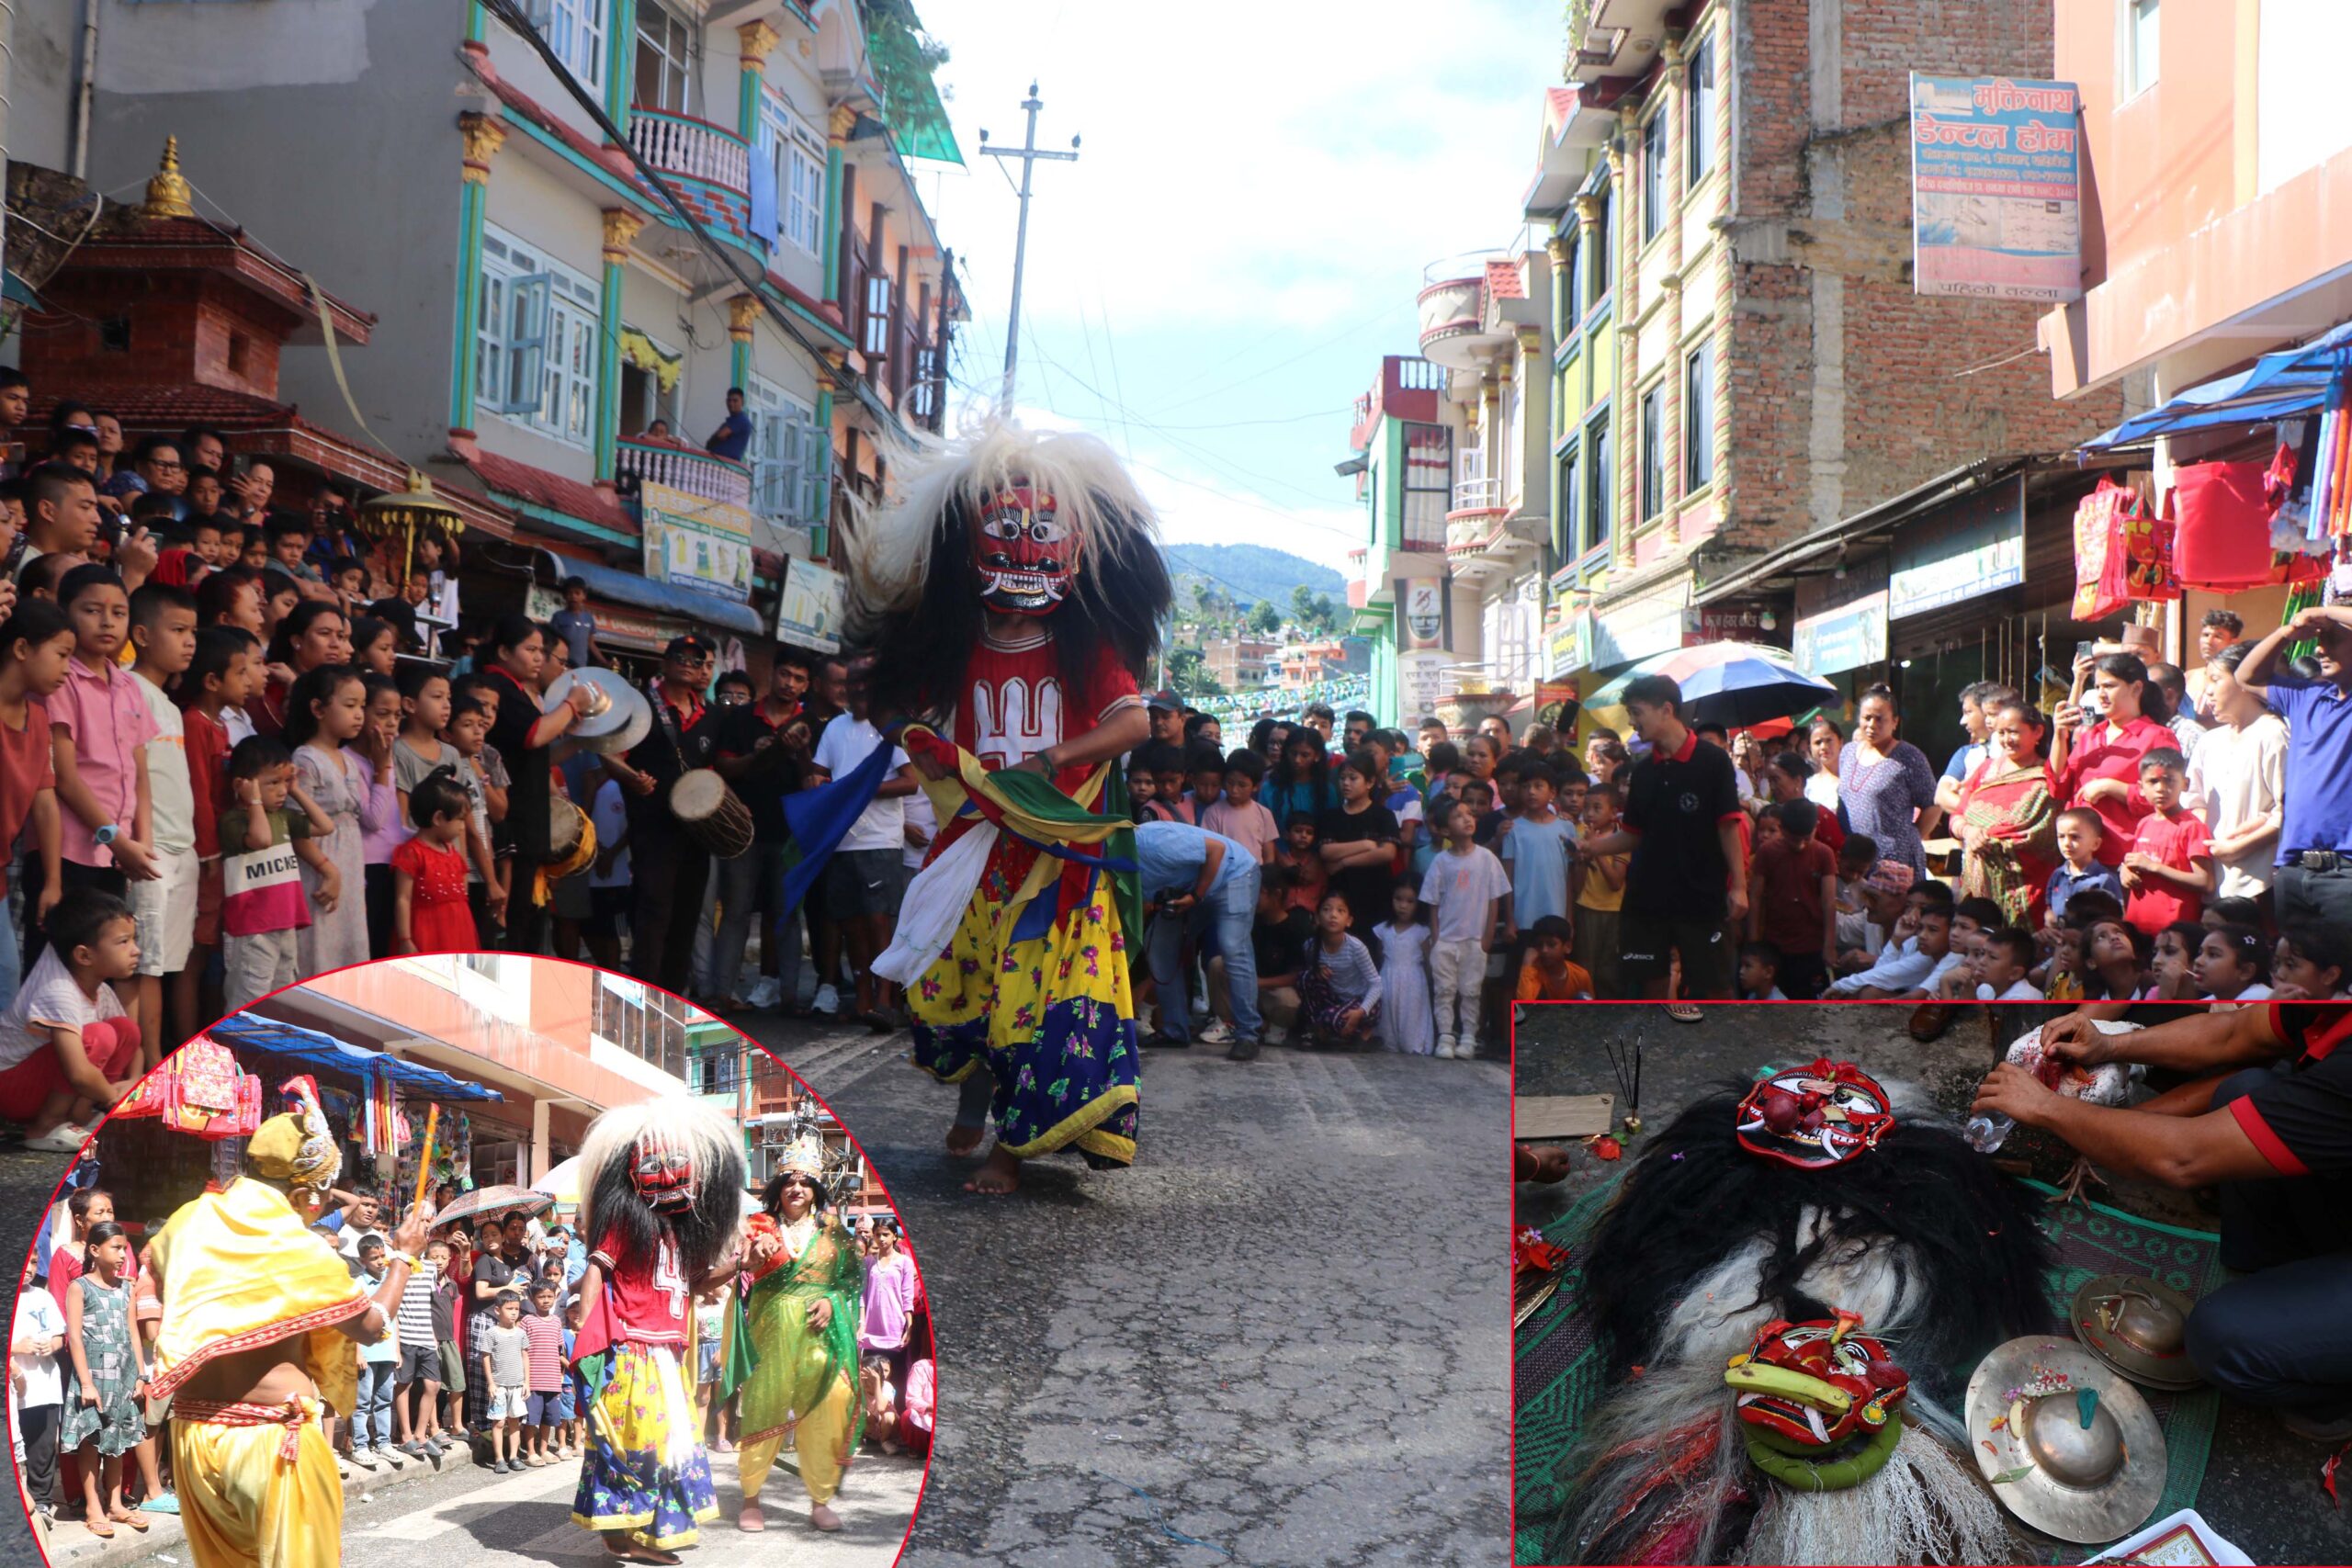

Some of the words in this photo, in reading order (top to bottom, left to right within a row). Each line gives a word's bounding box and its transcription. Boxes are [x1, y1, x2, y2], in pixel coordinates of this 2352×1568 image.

[1973, 78, 2075, 115] मुक्तिनाथ
[1916, 113, 2008, 149] डेन्टल
[2016, 119, 2075, 152] होम
[1940, 281, 1996, 295] पहिलो
[2005, 287, 2058, 299] तल्ला
